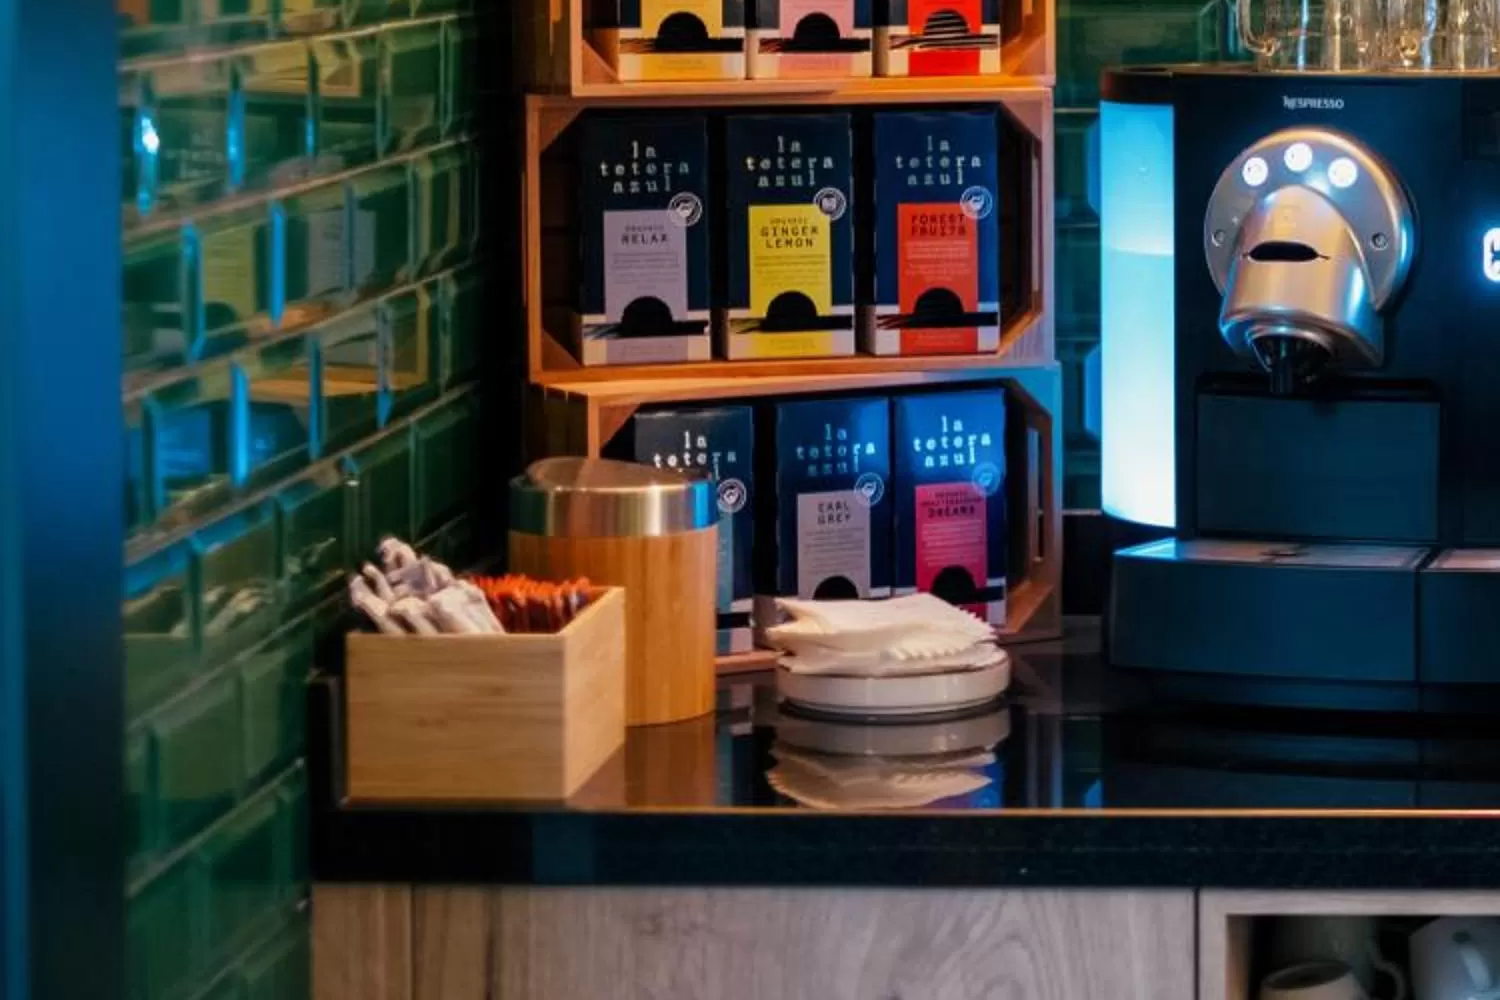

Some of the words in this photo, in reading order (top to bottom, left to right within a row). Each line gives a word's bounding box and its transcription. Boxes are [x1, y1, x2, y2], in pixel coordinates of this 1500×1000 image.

[632, 140, 656, 160] la
[777, 135, 802, 153] la
[926, 135, 950, 152] la
[600, 160, 690, 177] tetera
[745, 155, 834, 171] tetera
[895, 154, 982, 169] tetera
[760, 225, 819, 237] GINGER
[765, 237, 814, 249] LEMON
[941, 415, 963, 433] la
[684, 430, 707, 449] la
[913, 432, 992, 452] tetera
[653, 450, 737, 469] tetera
